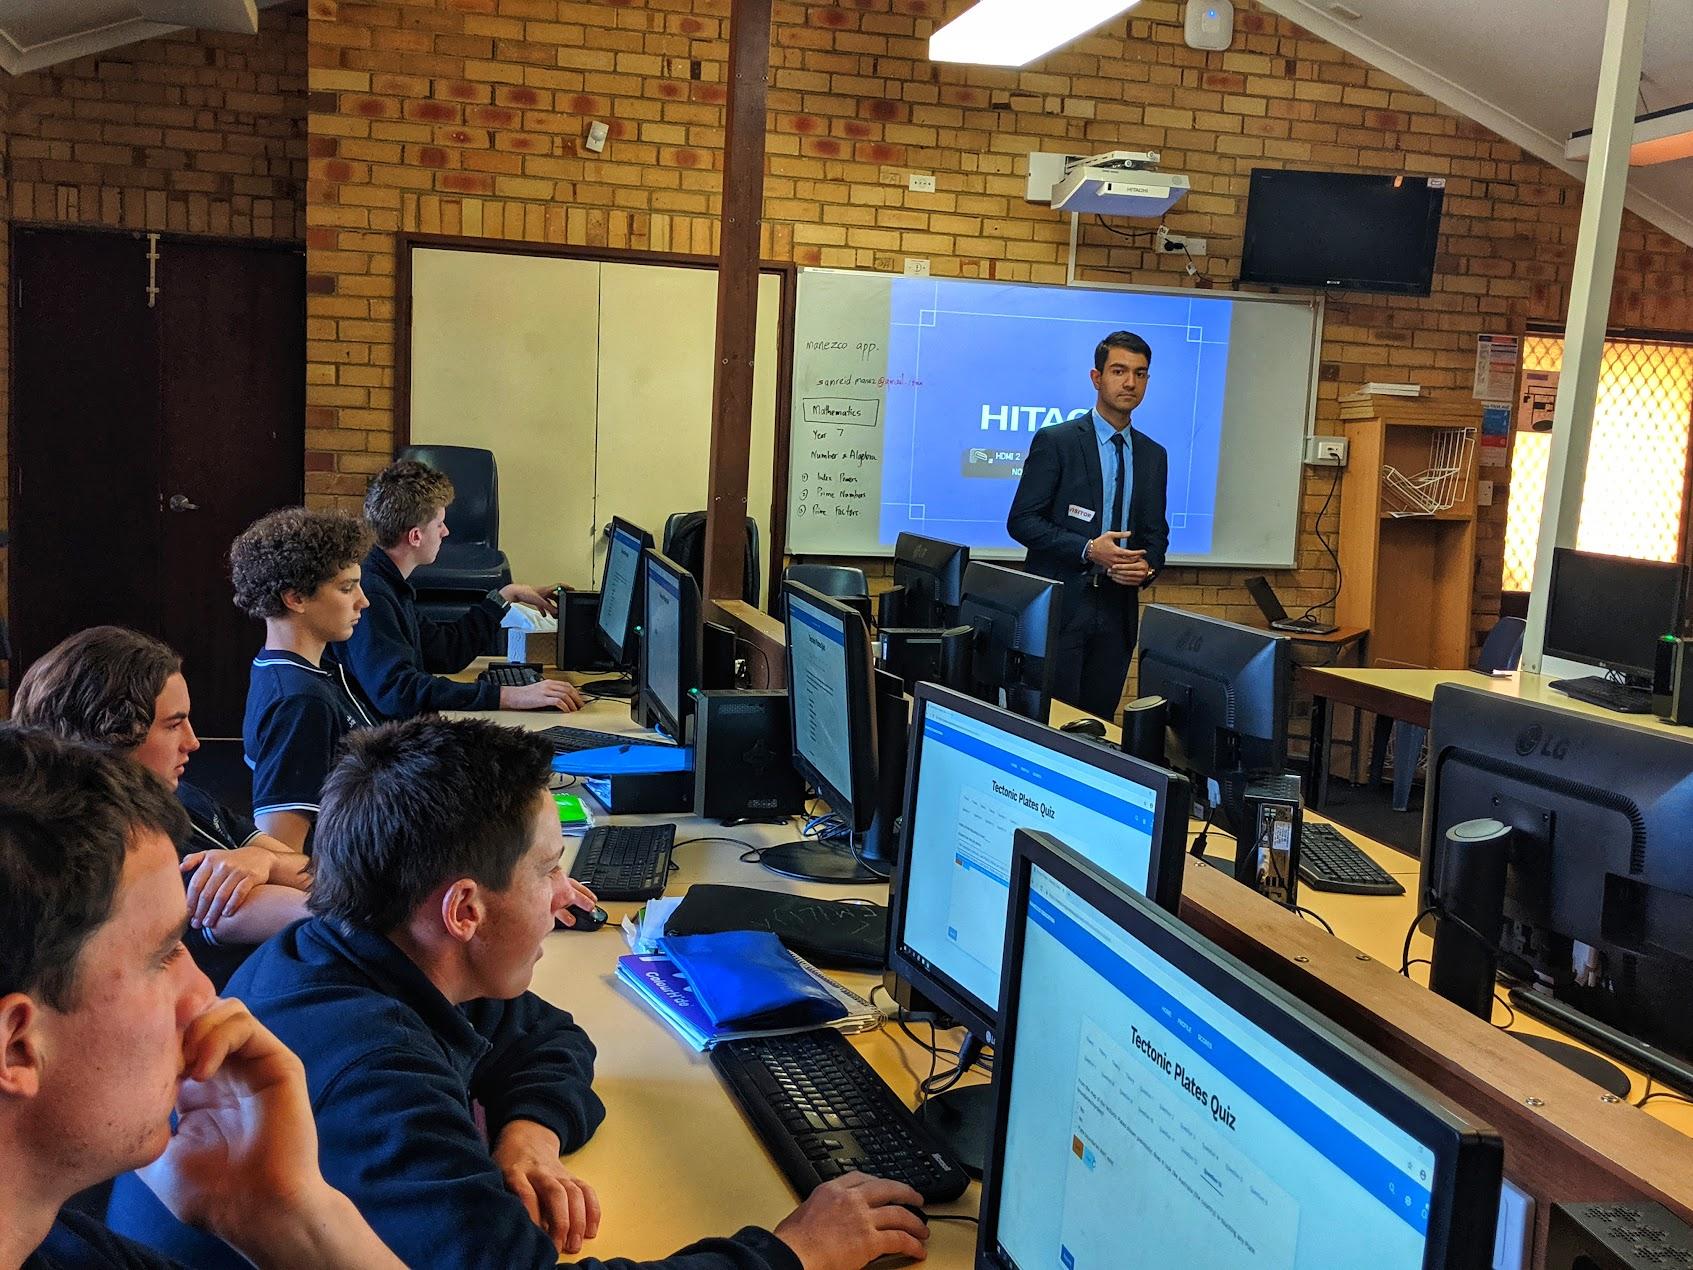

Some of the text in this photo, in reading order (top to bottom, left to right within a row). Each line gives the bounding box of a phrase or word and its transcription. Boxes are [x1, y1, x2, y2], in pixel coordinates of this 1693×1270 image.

[812, 404, 862, 417] Mathematics
[812, 428, 844, 440] Year 7
[811, 449, 838, 460] Number
[849, 449, 878, 468] Algebra
[995, 452, 1021, 461] HDMI 2
[816, 486, 835, 499] Prime
[839, 489, 866, 499] Numbers
[991, 779, 1018, 802] Tectonic
[1019, 792, 1039, 812] Plates
[1040, 802, 1056, 819] Quiz
[1130, 1024, 1236, 1131] Tectonic Plates Quiz
